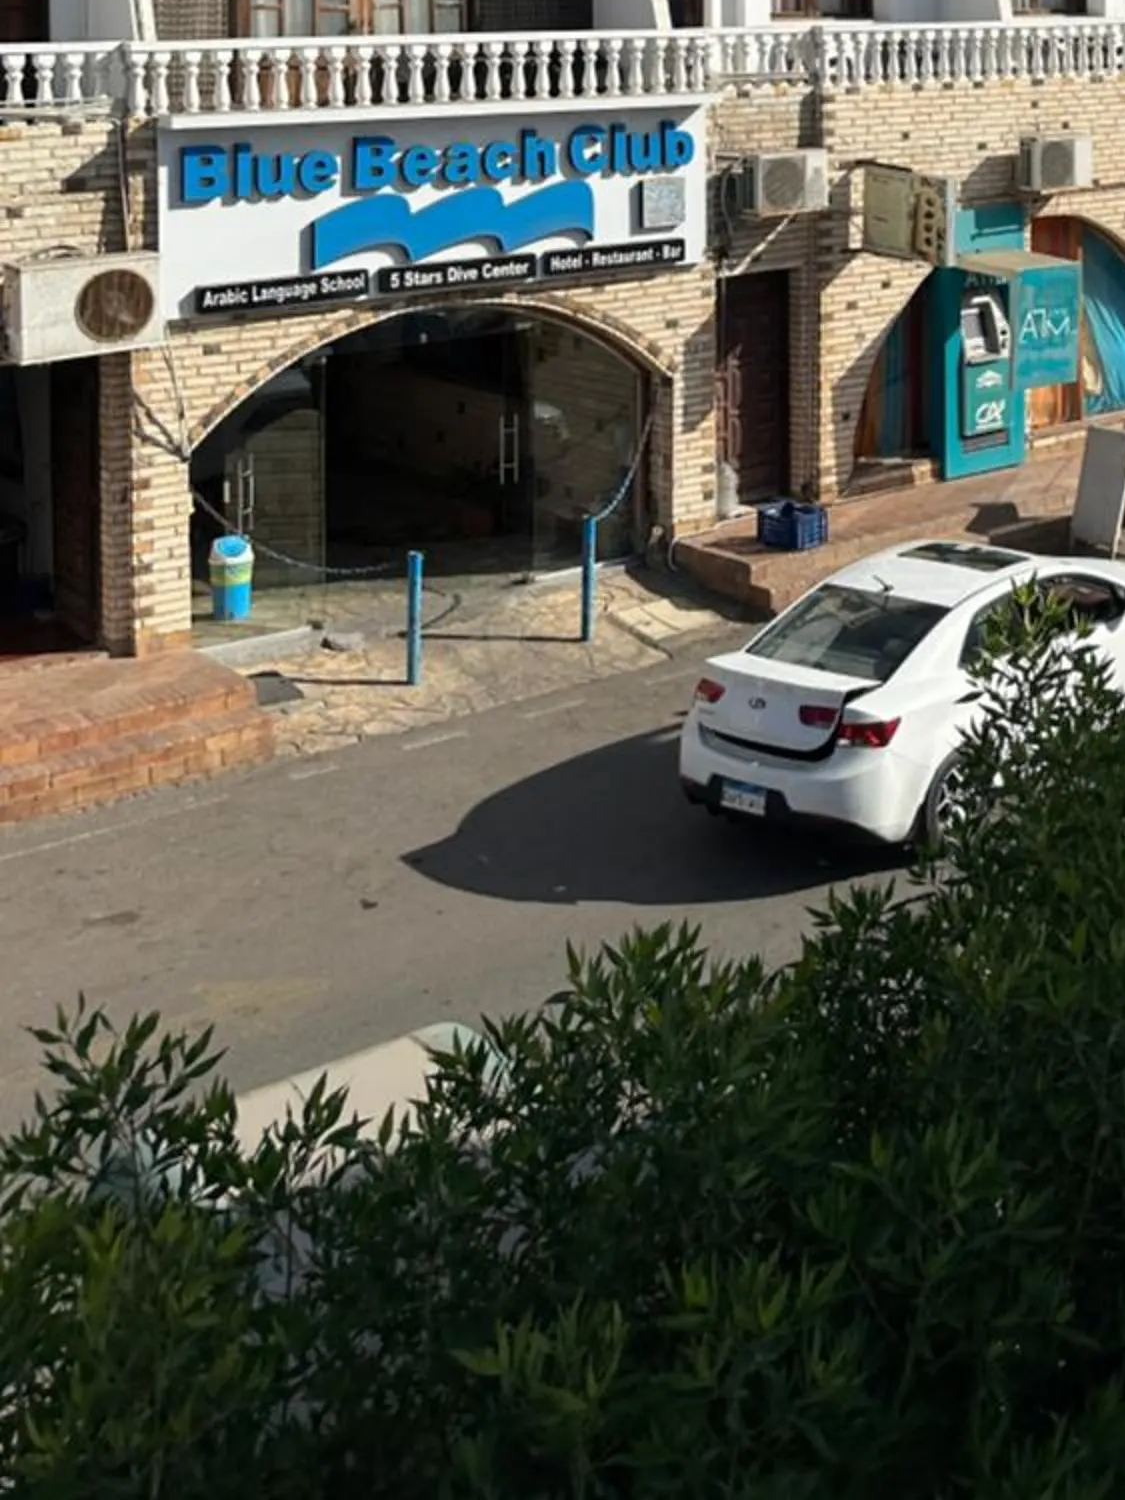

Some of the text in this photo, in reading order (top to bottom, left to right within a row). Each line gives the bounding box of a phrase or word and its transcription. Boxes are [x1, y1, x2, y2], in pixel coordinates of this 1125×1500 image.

[179, 119, 695, 203] Blue Beach Club
[389, 262, 530, 289] 5 Stars Dive Center
[550, 252, 583, 271] Hotel
[592, 248, 654, 268] Restaurant
[662, 244, 682, 260] Bar
[202, 273, 365, 309] Arabic Language School
[1018, 308, 1071, 345] ATM
